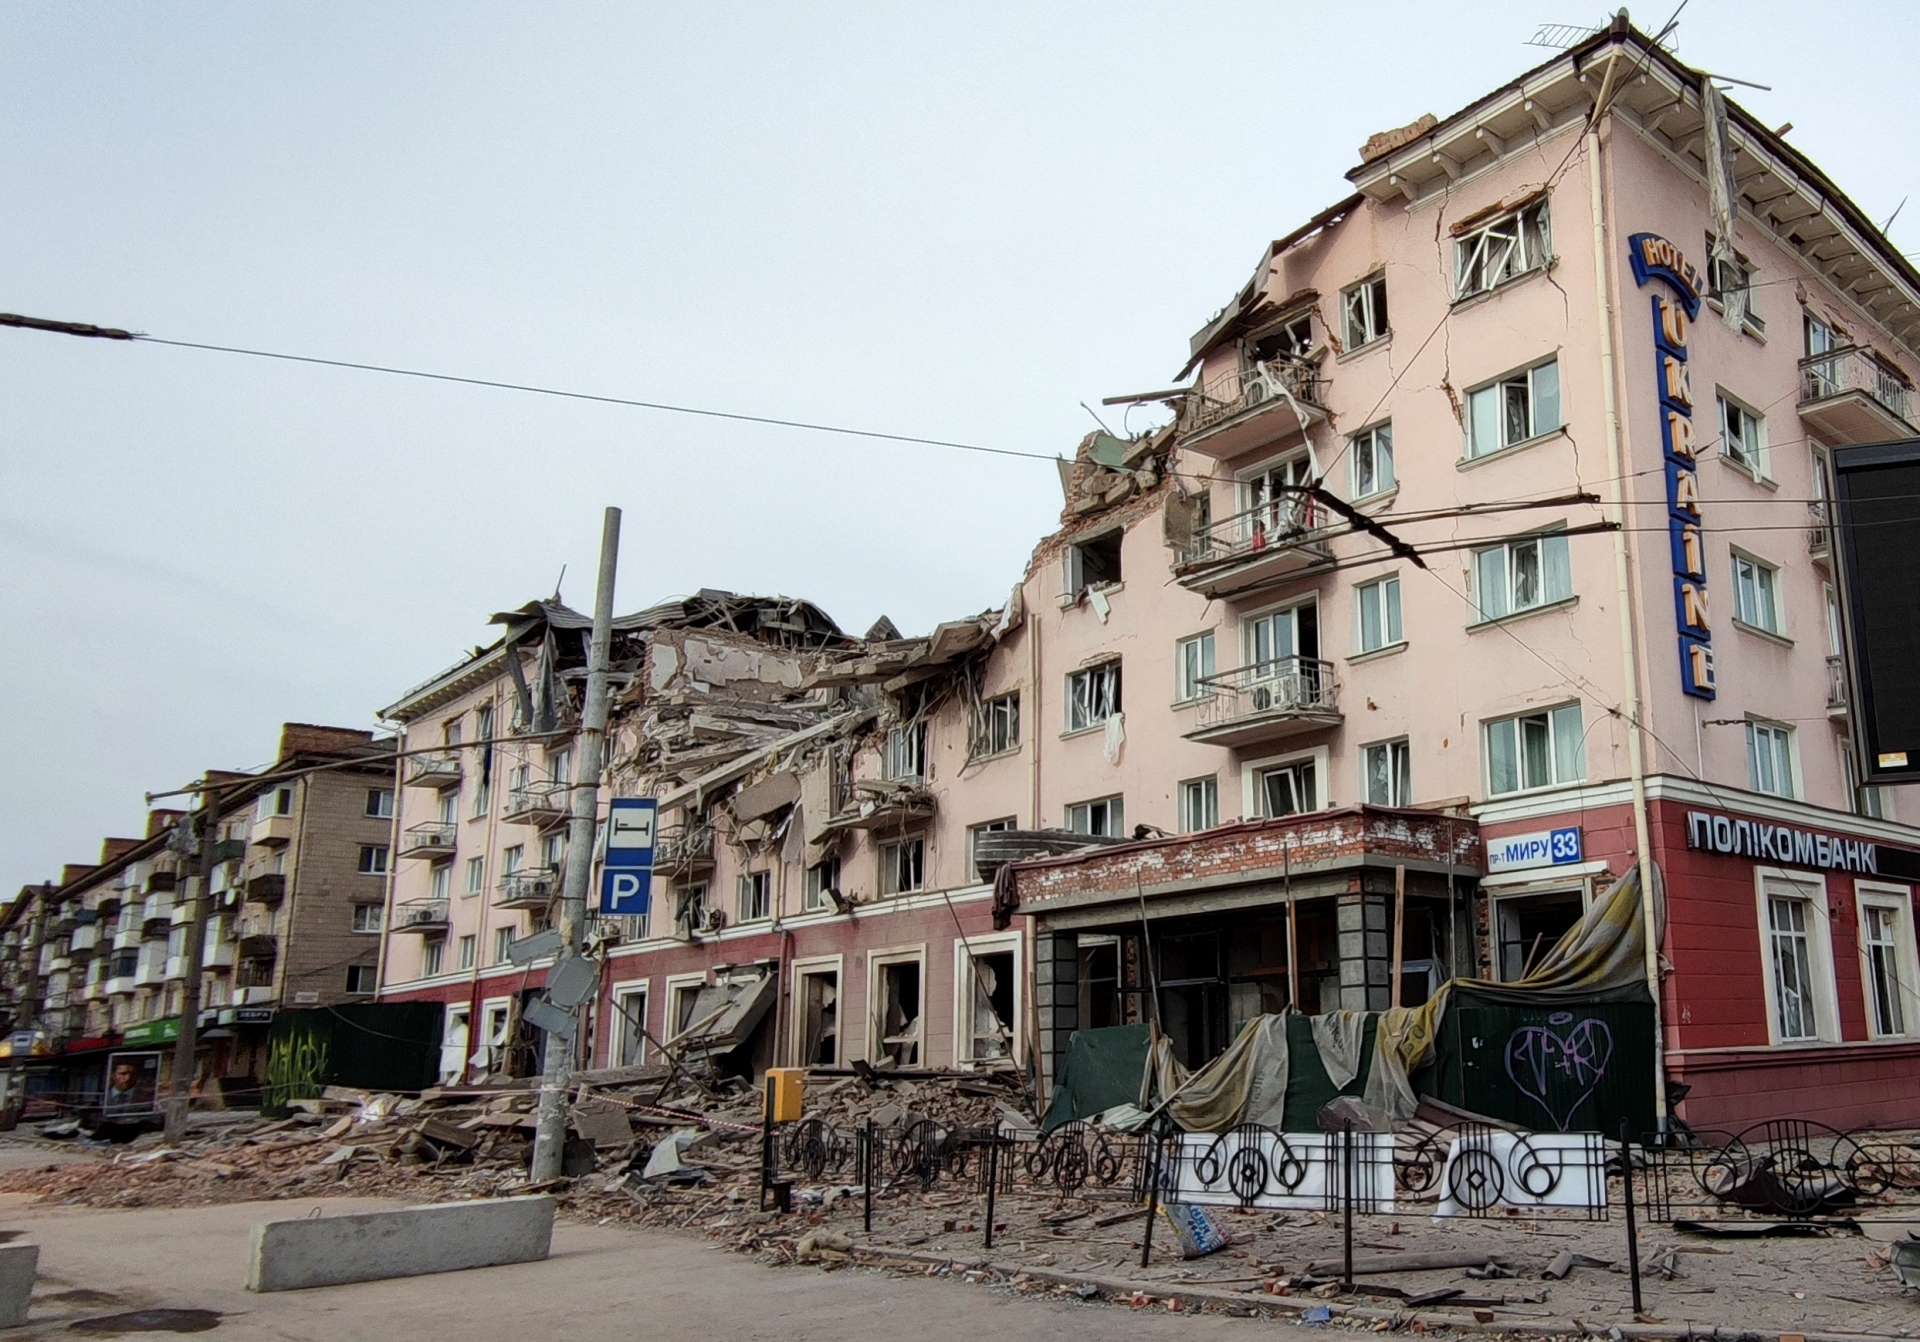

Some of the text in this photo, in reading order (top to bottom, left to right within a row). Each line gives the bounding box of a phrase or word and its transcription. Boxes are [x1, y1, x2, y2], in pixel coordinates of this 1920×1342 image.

[1642, 238, 1700, 298] HOTEL
[1506, 839, 1549, 862] МИРУ
[1554, 832, 1577, 857] 33
[1688, 811, 1876, 874] ПОЛІКОМБАНК
[612, 874, 639, 909] P
